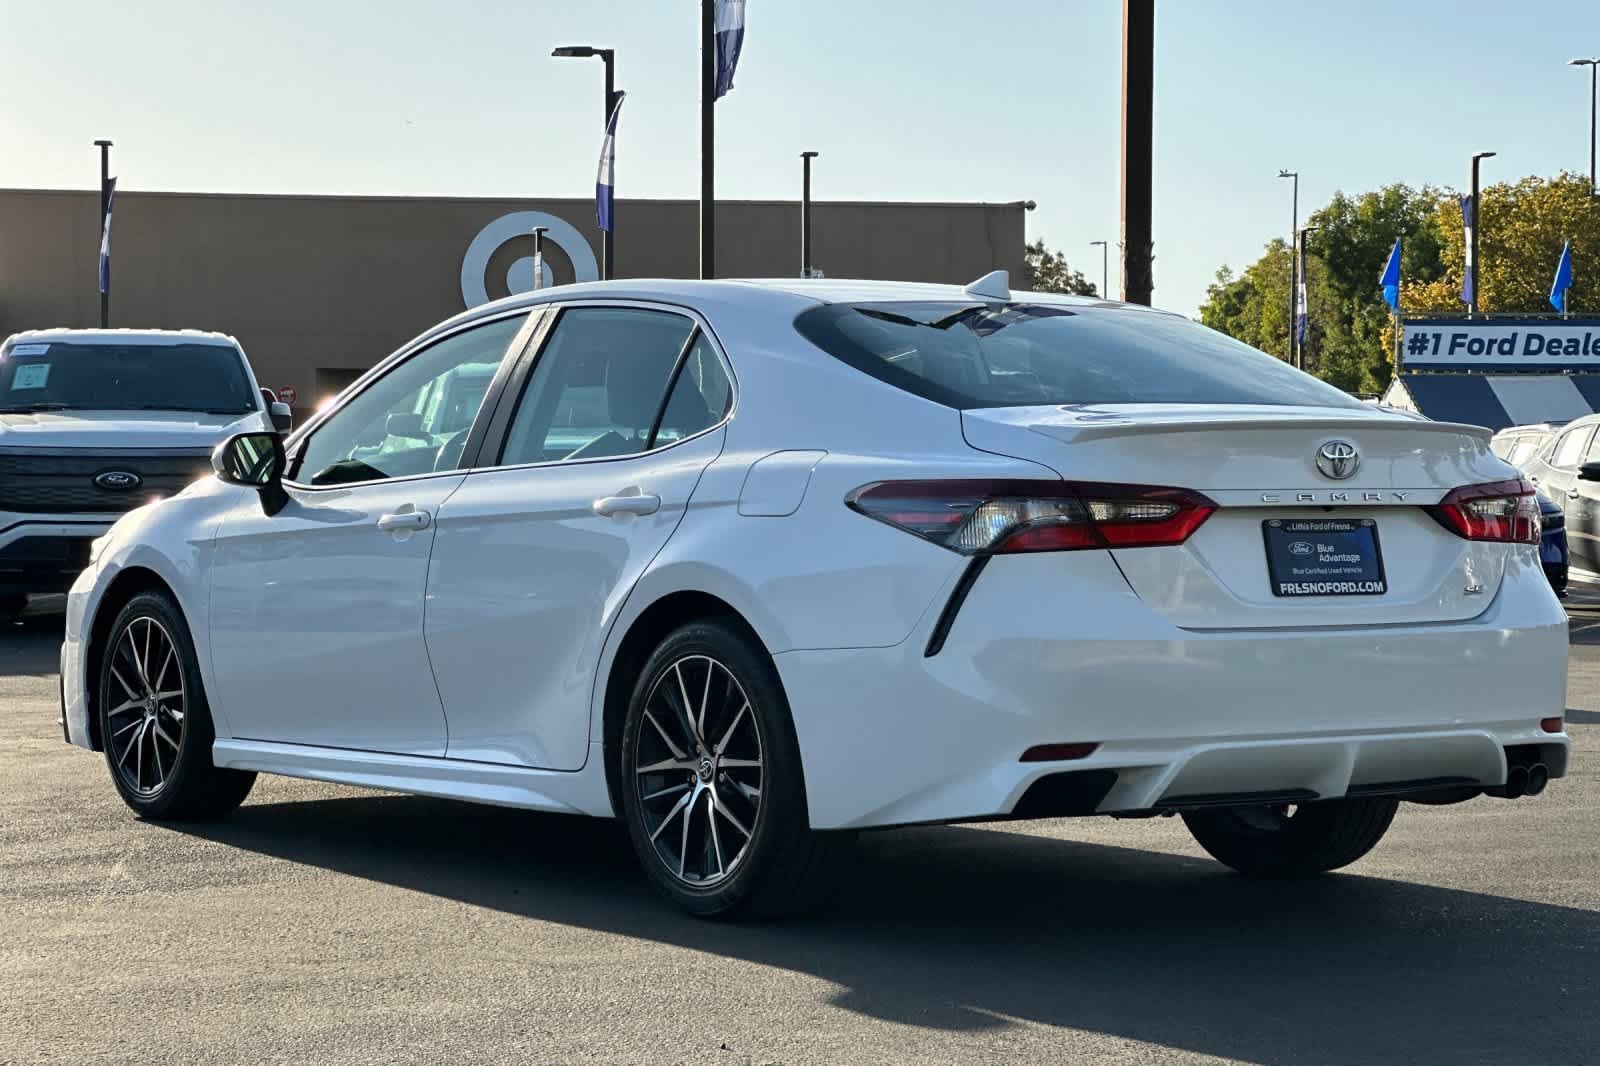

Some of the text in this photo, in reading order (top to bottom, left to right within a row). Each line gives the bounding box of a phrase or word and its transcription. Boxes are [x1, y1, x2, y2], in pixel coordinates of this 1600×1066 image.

[1407, 333, 1442, 356] #1
[1448, 332, 1518, 356] Ford
[1262, 492, 1408, 503] CAMRY
[1317, 544, 1335, 553] Blue
[1320, 554, 1361, 563] Advantage
[1280, 582, 1384, 594] FRESNOFORD.COM
